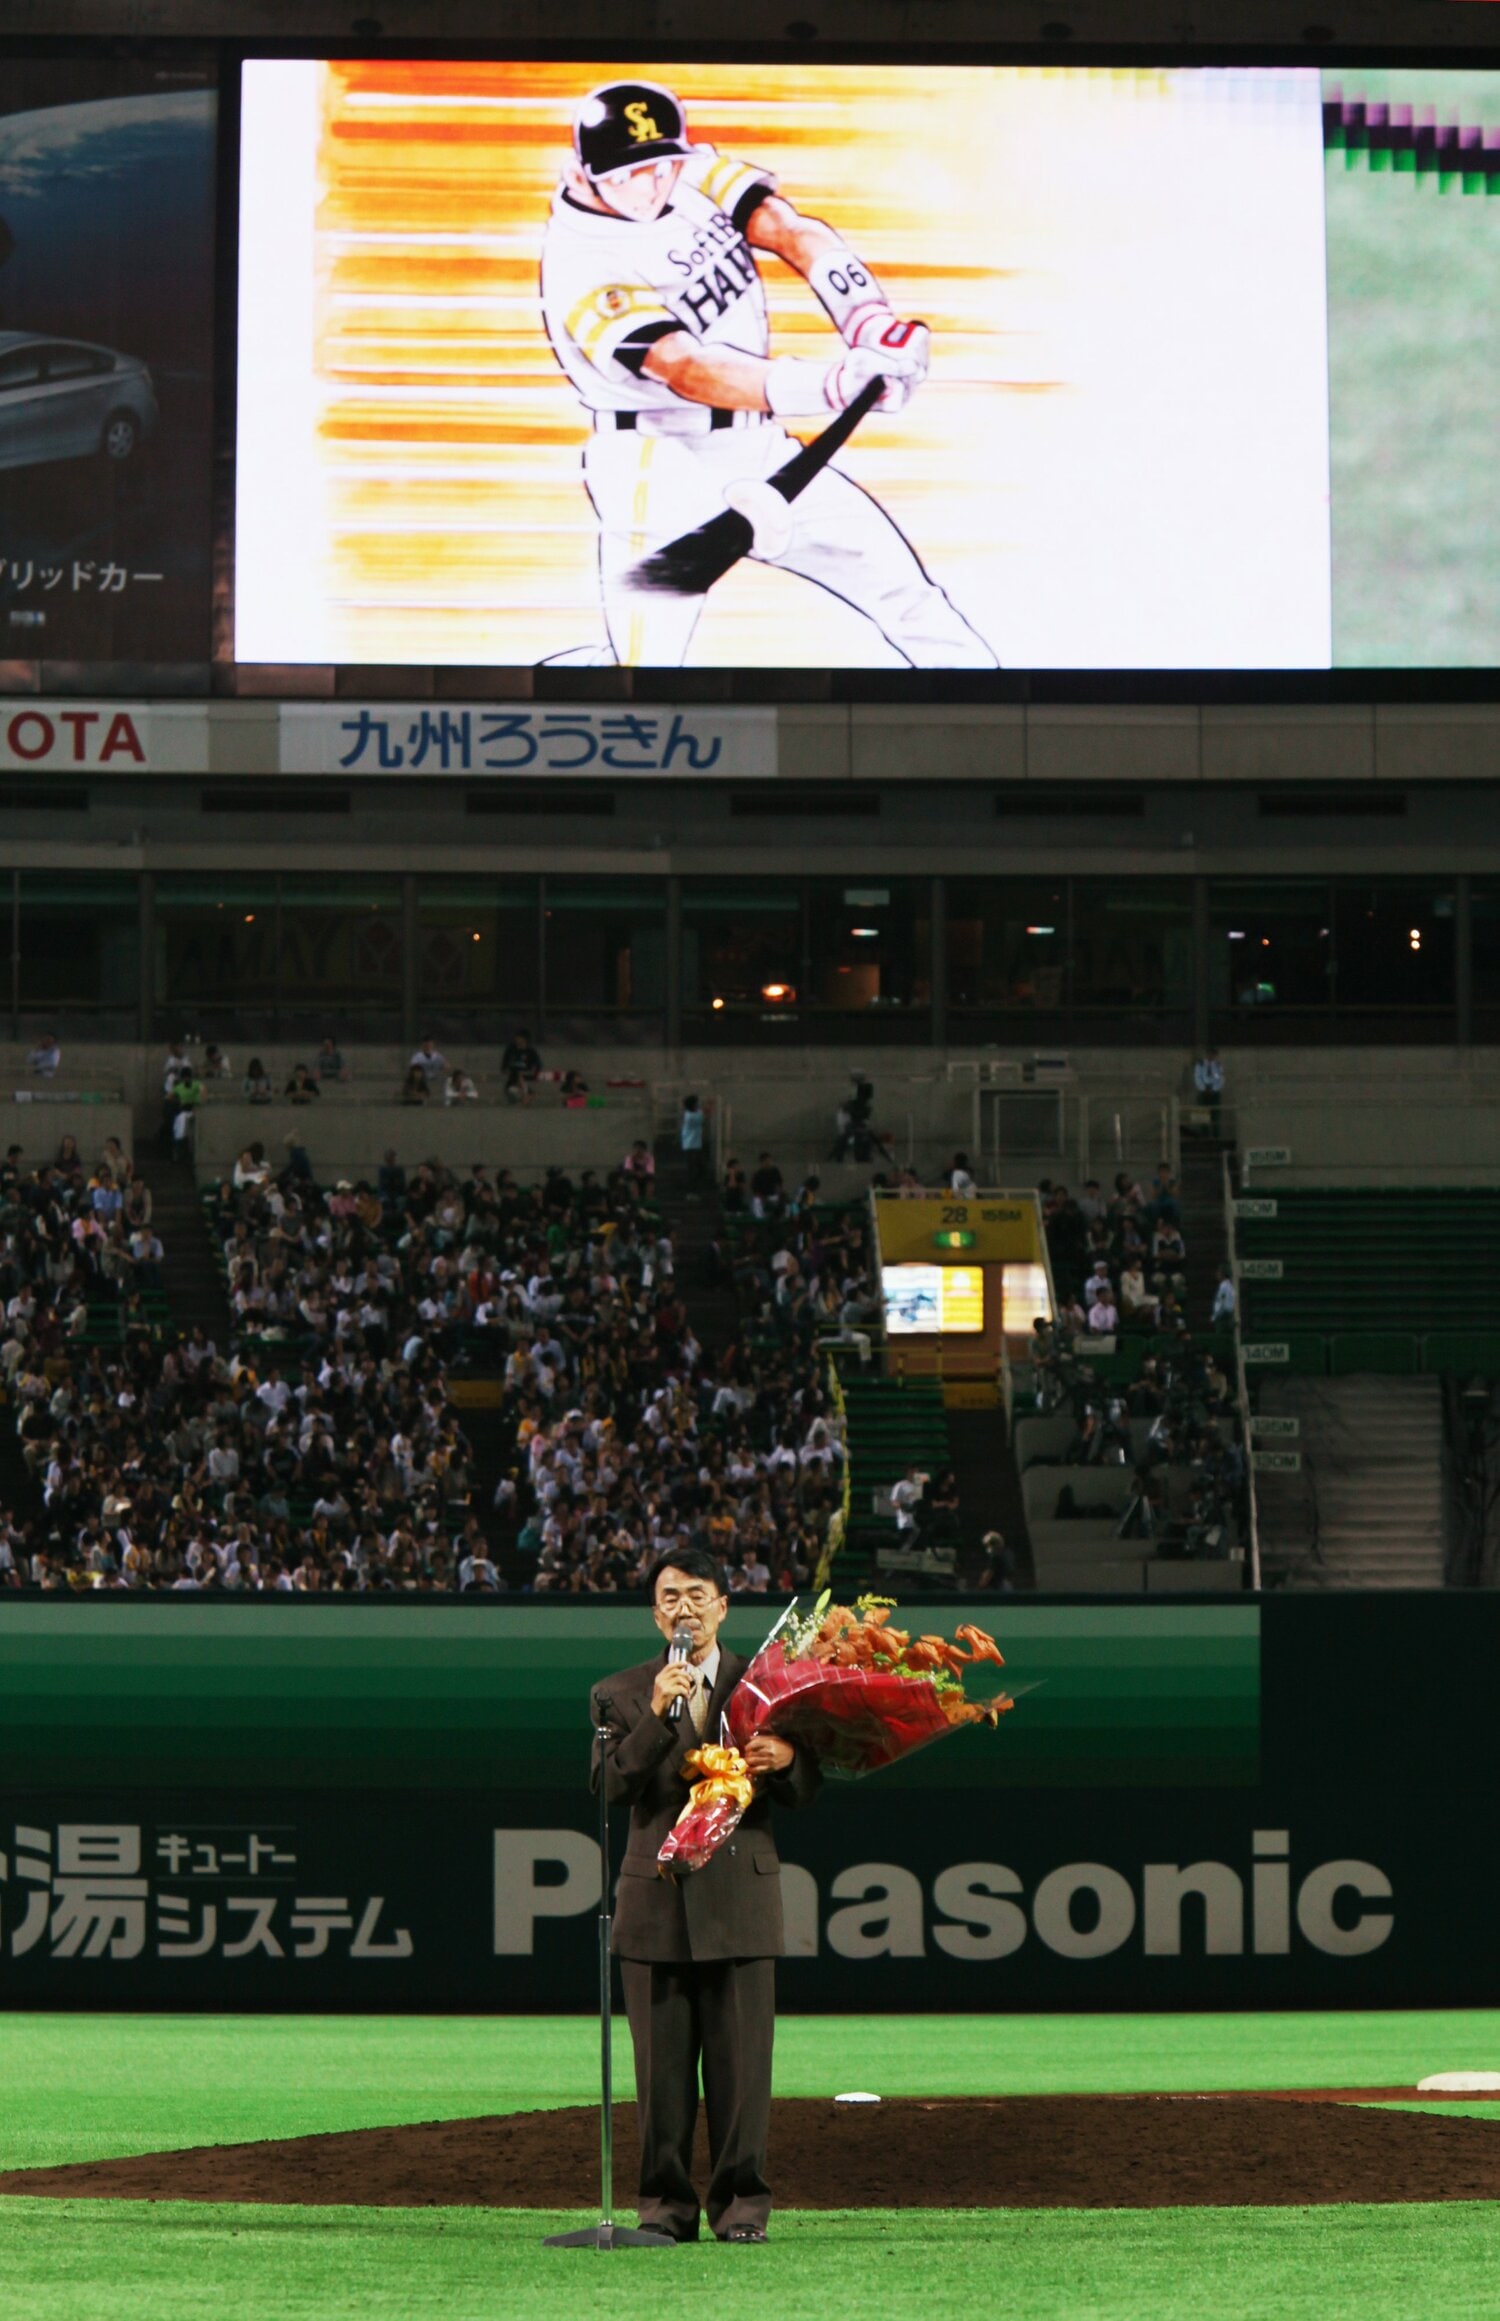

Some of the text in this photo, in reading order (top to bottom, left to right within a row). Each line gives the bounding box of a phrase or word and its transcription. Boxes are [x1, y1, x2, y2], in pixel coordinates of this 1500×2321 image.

[828, 263, 867, 296] 06
[339, 709, 723, 771] 九州ろうきん
[941, 1205, 968, 1224] 28
[0, 1824, 149, 1959] 湯
[493, 1828, 1395, 1961] Pasonic
[157, 1896, 414, 1958] システム
